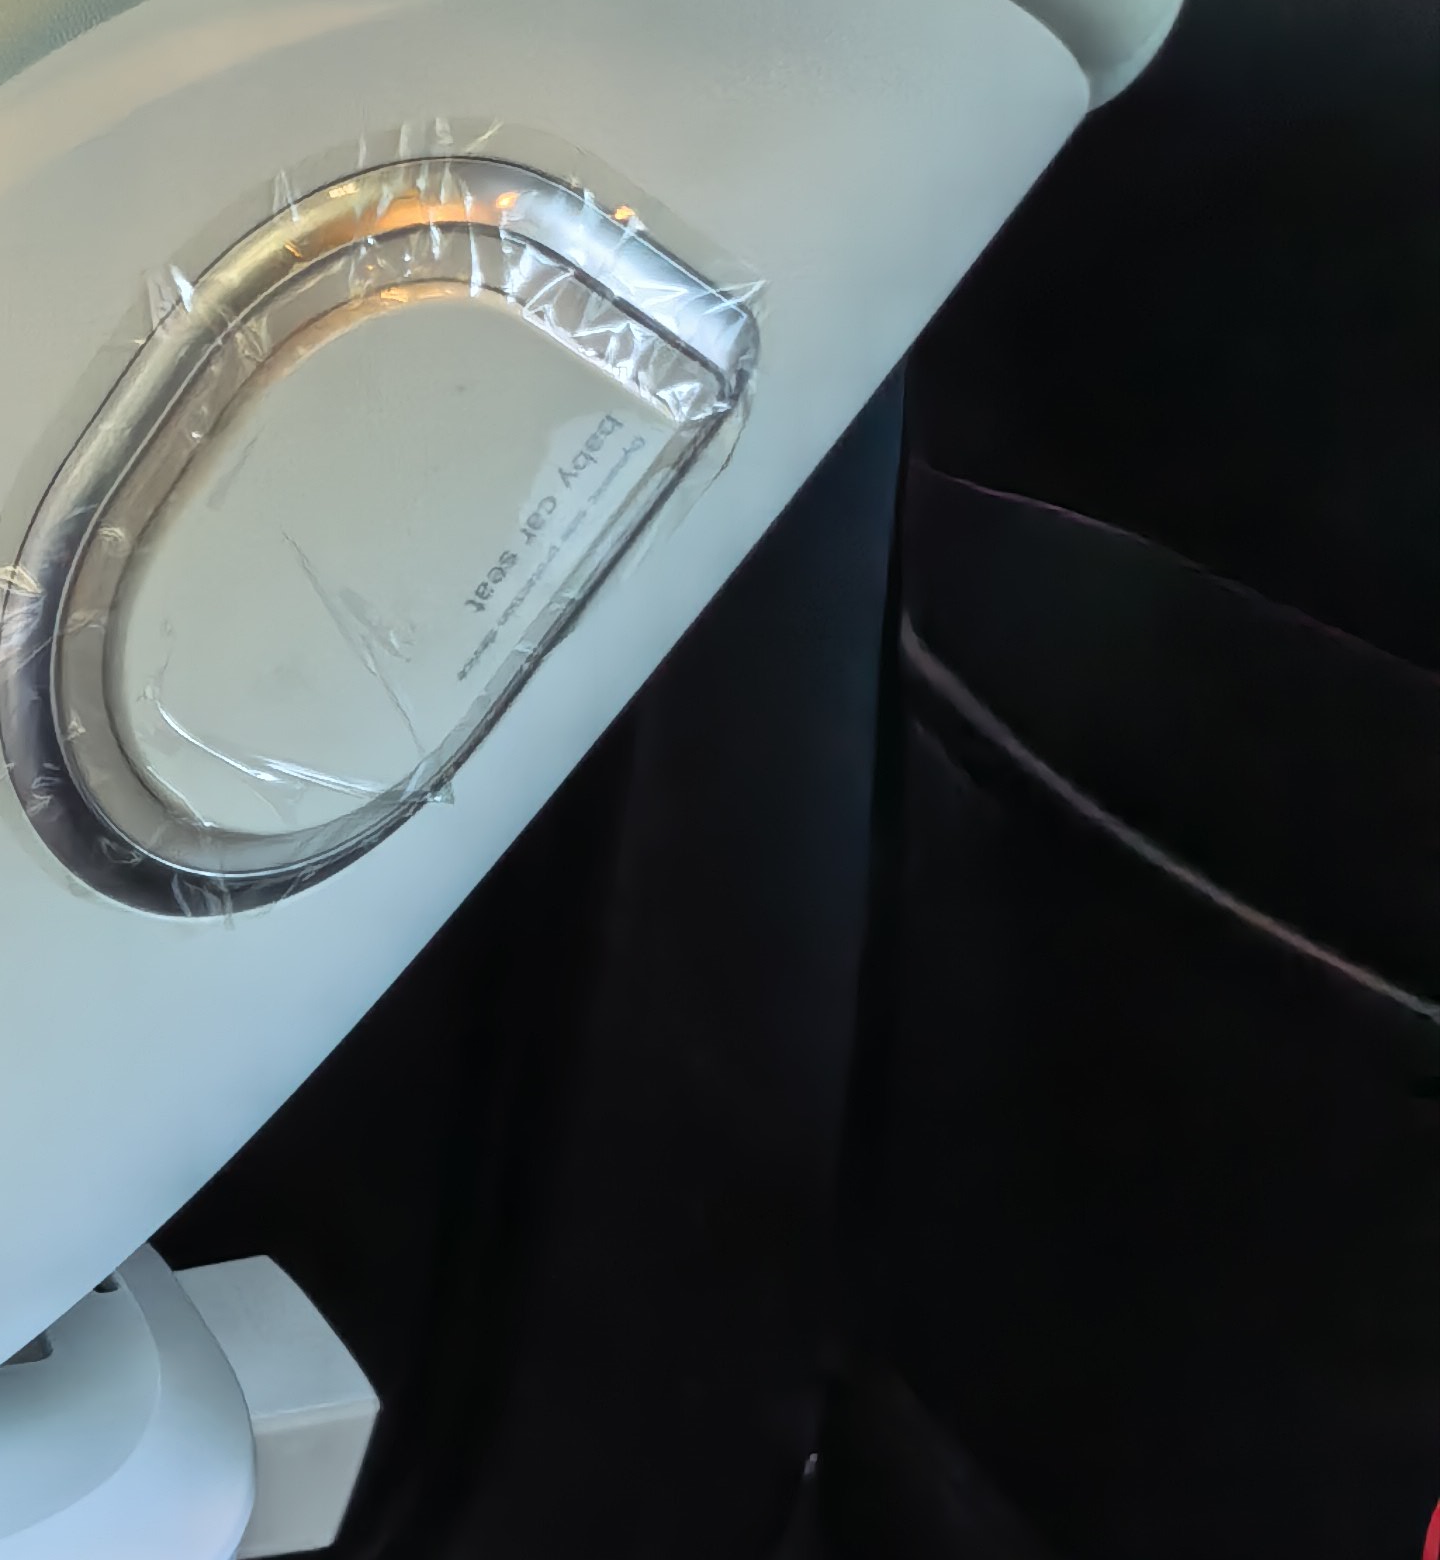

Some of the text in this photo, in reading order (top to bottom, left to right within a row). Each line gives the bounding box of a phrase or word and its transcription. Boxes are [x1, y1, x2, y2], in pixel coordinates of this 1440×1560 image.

[465, 414, 623, 613] baby car seat
